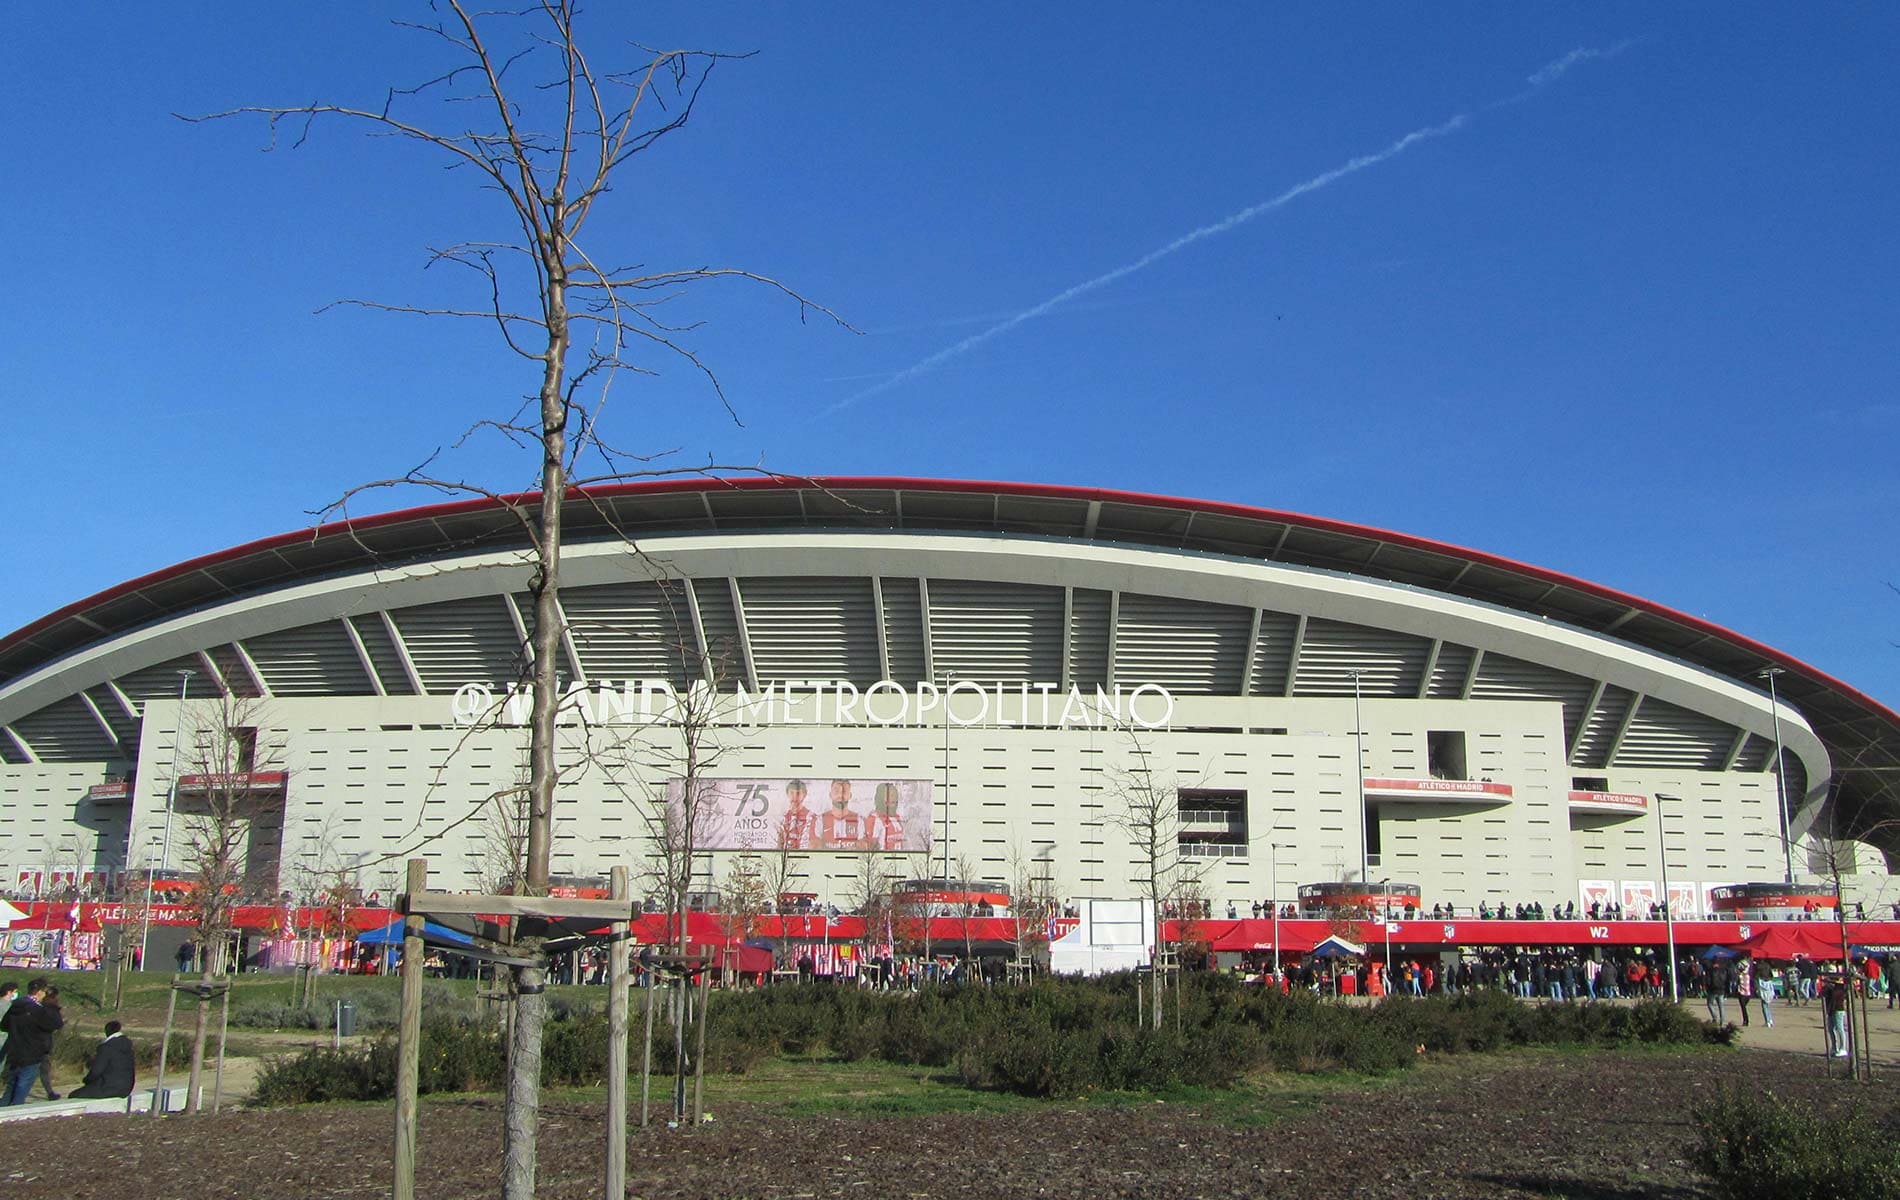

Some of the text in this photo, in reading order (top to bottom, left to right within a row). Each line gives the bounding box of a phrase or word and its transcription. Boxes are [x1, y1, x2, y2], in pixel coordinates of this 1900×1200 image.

[737, 680, 1174, 727] METROPOLITANO
[1456, 784, 1484, 792] MADRID
[735, 784, 769, 817] 75
[1590, 926, 1609, 938] W2
